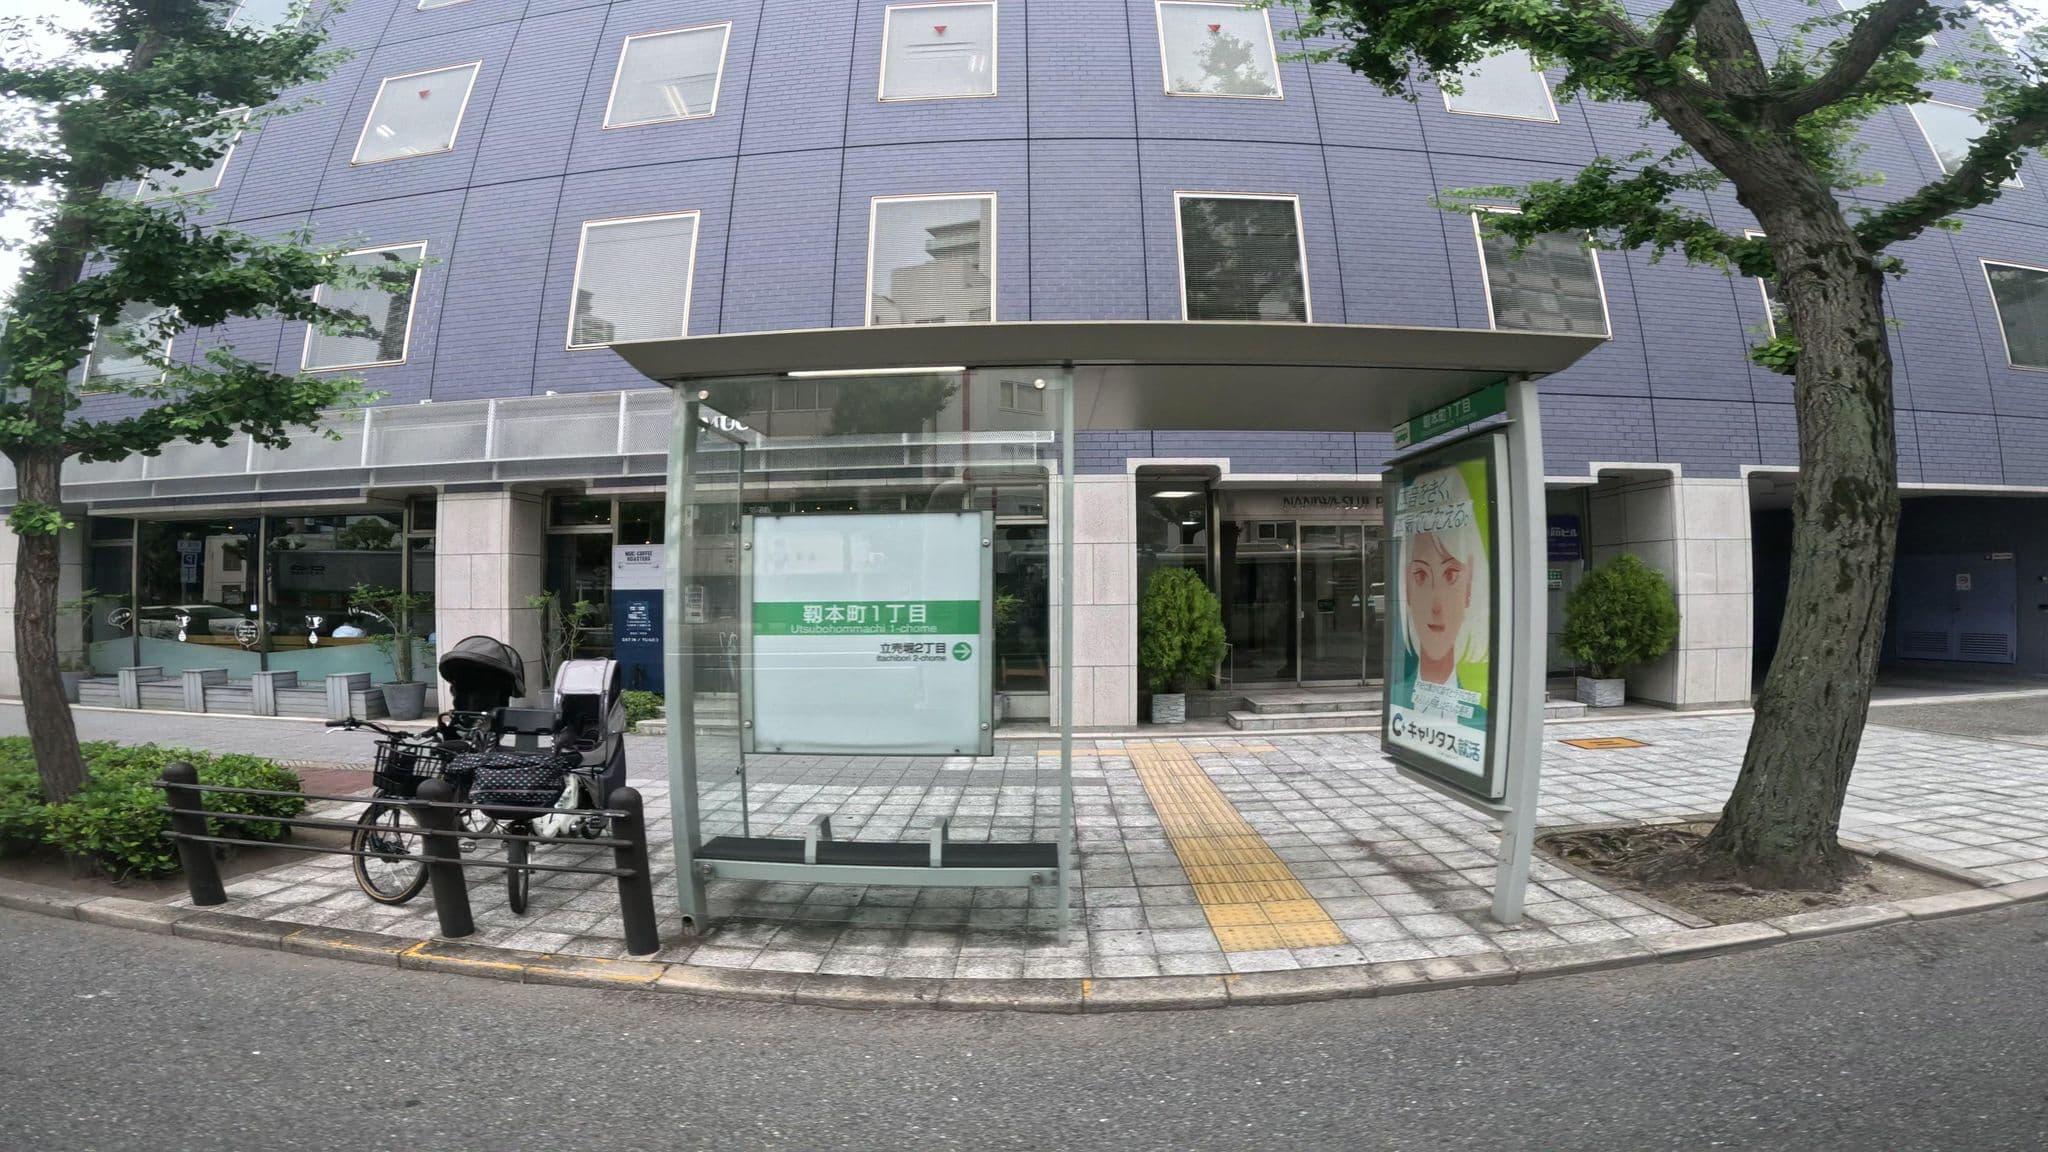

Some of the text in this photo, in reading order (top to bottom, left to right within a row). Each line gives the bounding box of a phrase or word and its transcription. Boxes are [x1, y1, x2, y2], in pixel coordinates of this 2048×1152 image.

[803, 604, 927, 623] 靱本町1丁目
[791, 624, 937, 634] Utsubohommachi 1-chome
